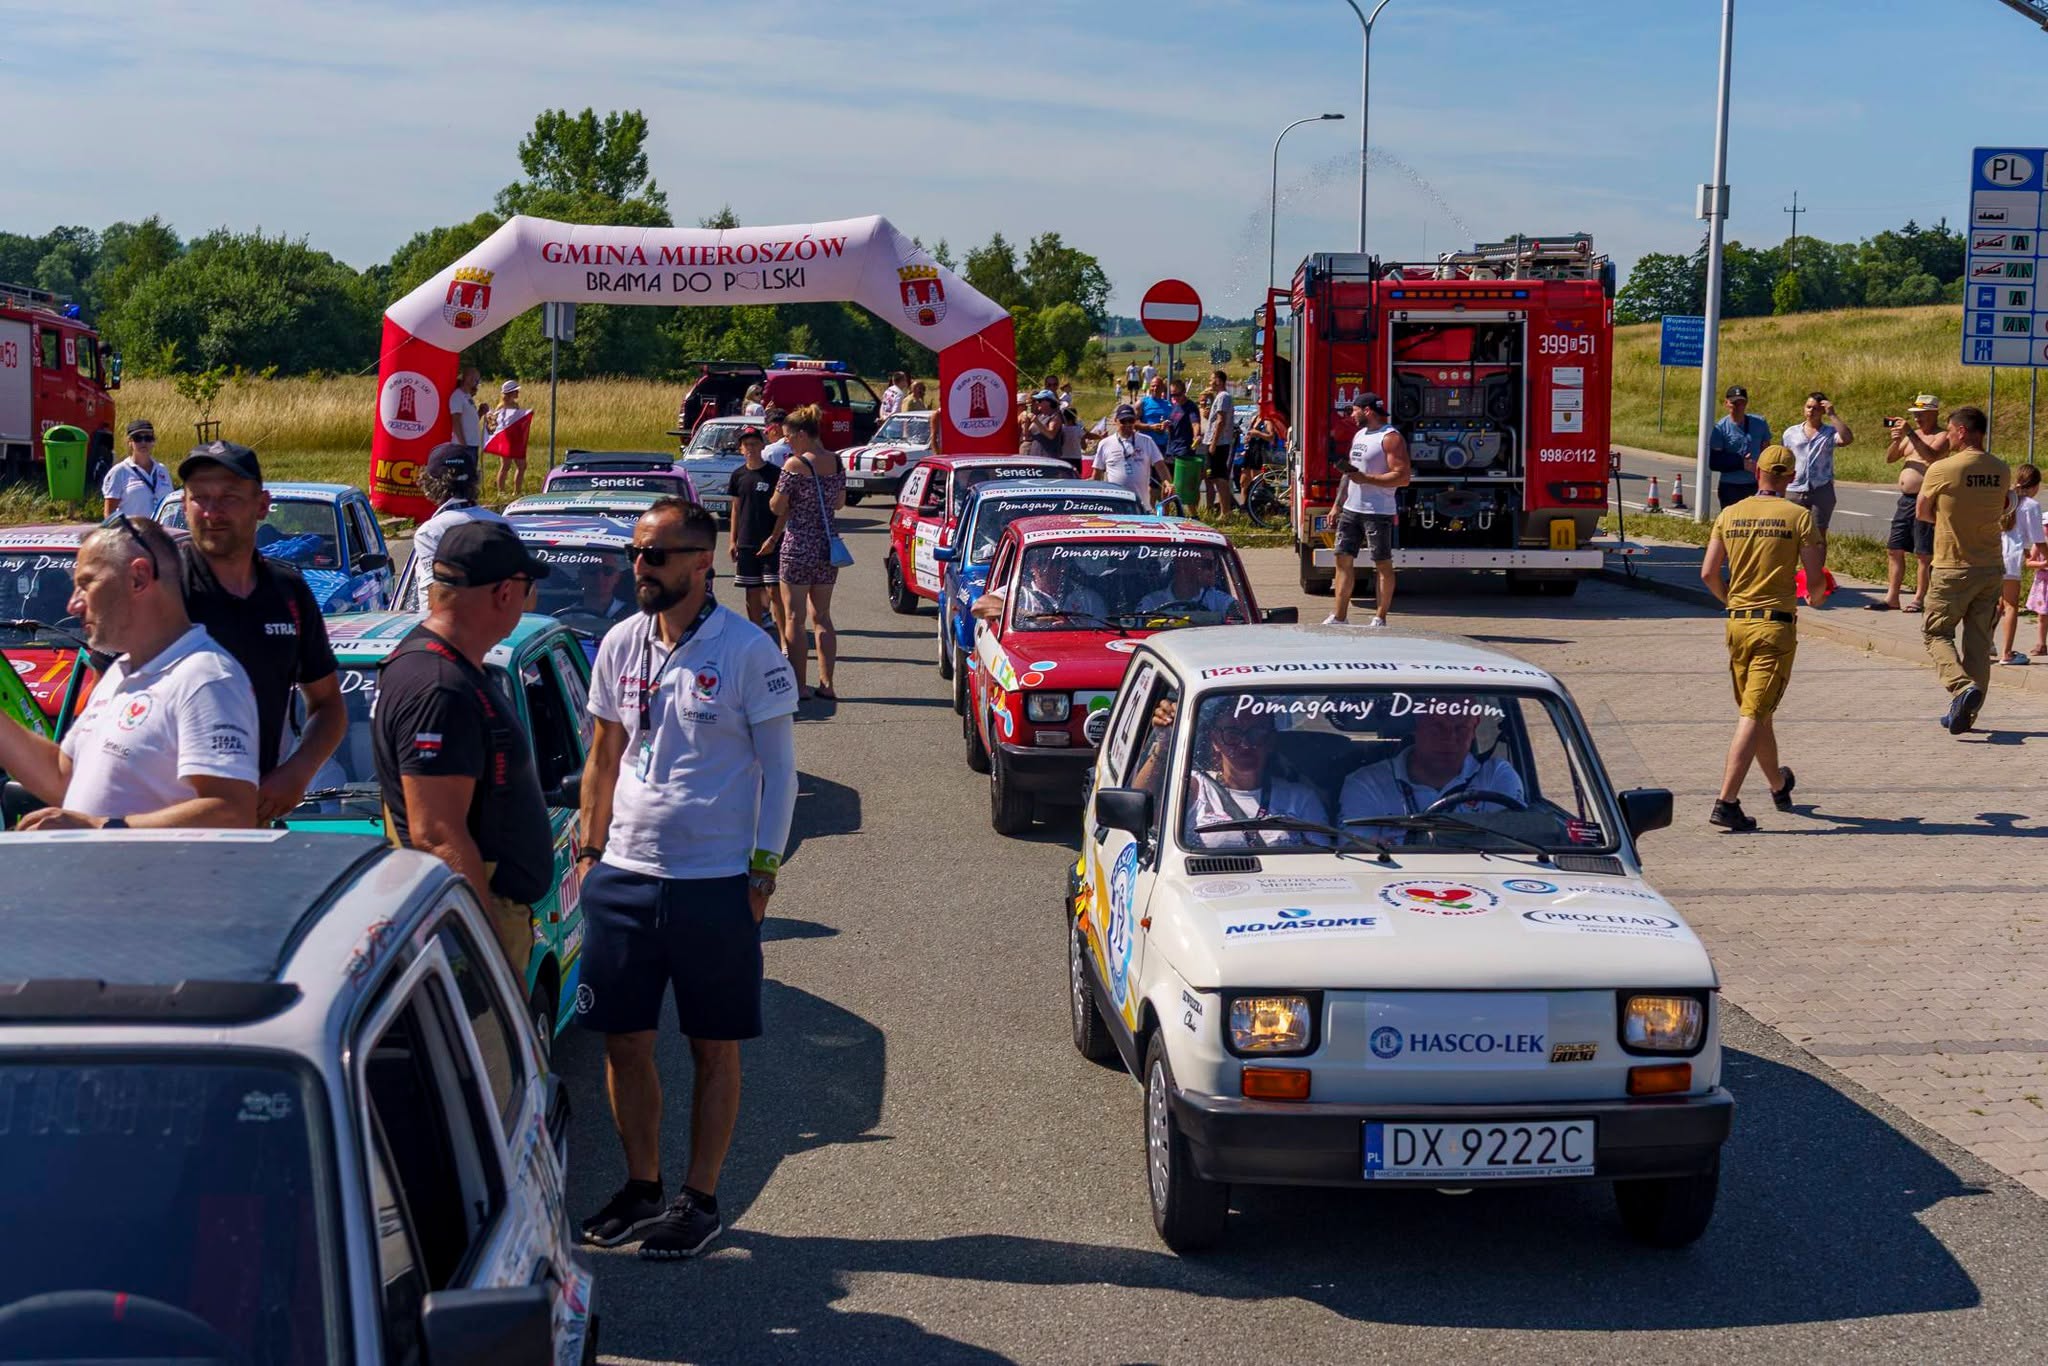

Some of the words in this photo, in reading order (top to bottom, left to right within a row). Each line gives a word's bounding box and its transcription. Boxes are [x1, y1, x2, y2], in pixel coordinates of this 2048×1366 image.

[1992, 158, 2023, 181] PL
[542, 242, 648, 266] GMINA
[656, 234, 848, 266] MIEROSZÓW
[586, 272, 661, 292] BRAMA
[673, 272, 712, 292] DO
[1540, 448, 1561, 463] 998
[1575, 448, 1596, 463] 112
[995, 467, 1043, 477] Senetic
[591, 477, 645, 488] Senetic
[998, 501, 1058, 512] Pomagamy
[1063, 500, 1113, 512] Dzieciom
[536, 549, 603, 564] Dzieciom
[1052, 545, 1129, 560] Pomagamy
[1138, 545, 1202, 559] Dzieciom
[33, 555, 79, 570] Dziec
[1410, 663, 1548, 678] STARS4STARS
[1233, 693, 1373, 720] Pomagamy
[1389, 692, 1506, 718] Dzieciom
[683, 707, 718, 721] Senetic
[1225, 917, 1377, 935] NOVASOME
[1544, 912, 1659, 926] PROCEFAR
[1410, 1033, 1544, 1053] HASCO-LEK
[1393, 1128, 1444, 1166] DX
[1461, 1126, 1583, 1166] 9222C
[1367, 1152, 1382, 1164] PL
